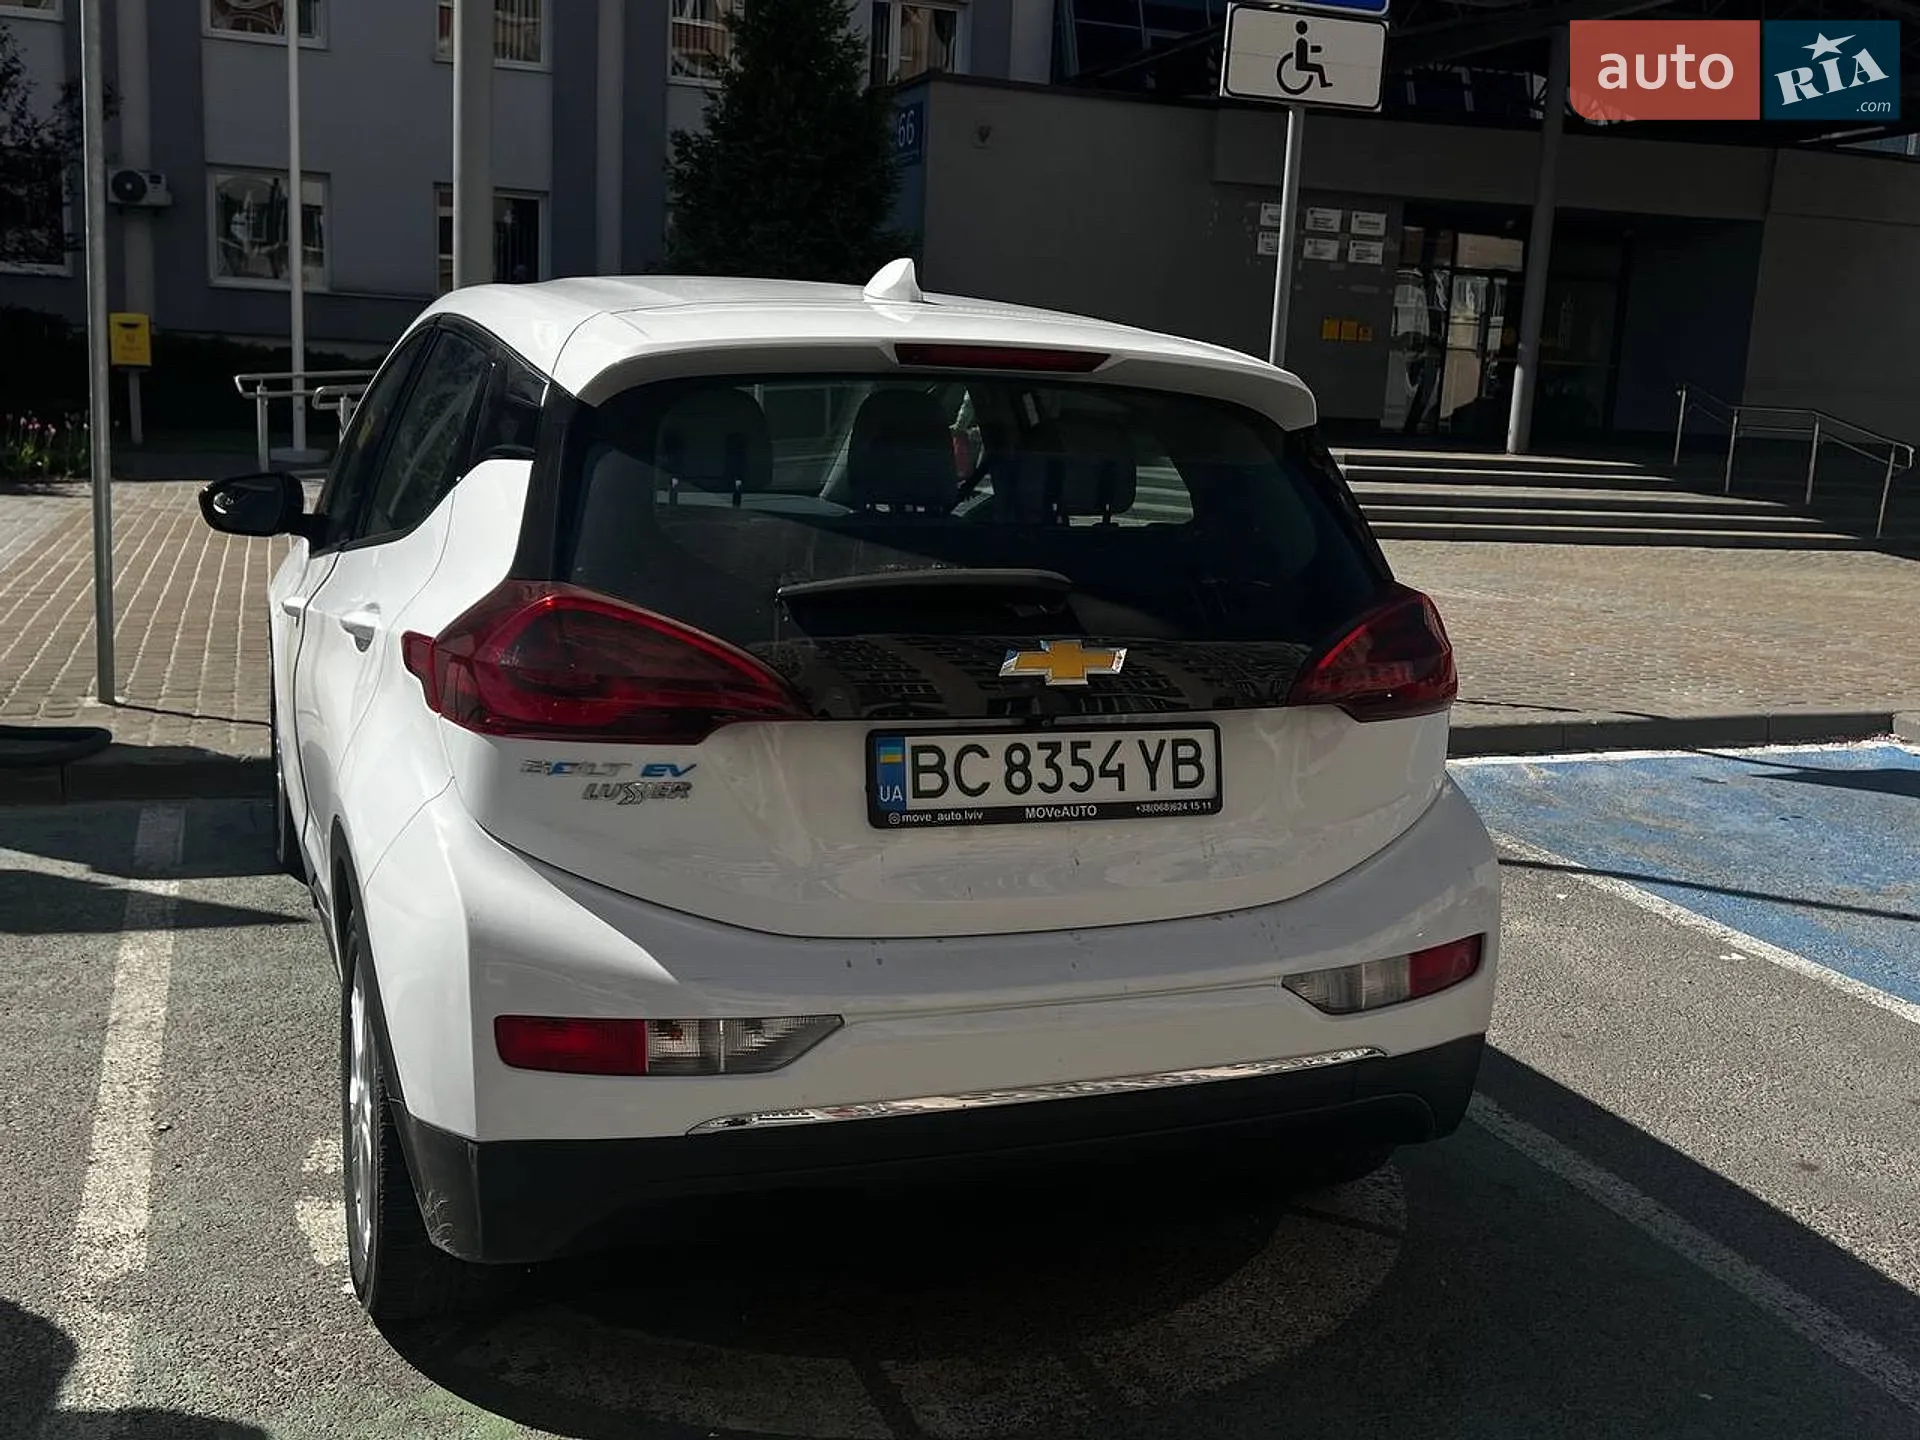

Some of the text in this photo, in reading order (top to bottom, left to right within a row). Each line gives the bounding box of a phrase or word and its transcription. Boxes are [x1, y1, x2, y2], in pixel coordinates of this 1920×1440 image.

[898, 109, 915, 148] 66
[641, 763, 697, 778] EV
[911, 738, 1205, 799] BC 8354 YB
[879, 785, 904, 802] UA
